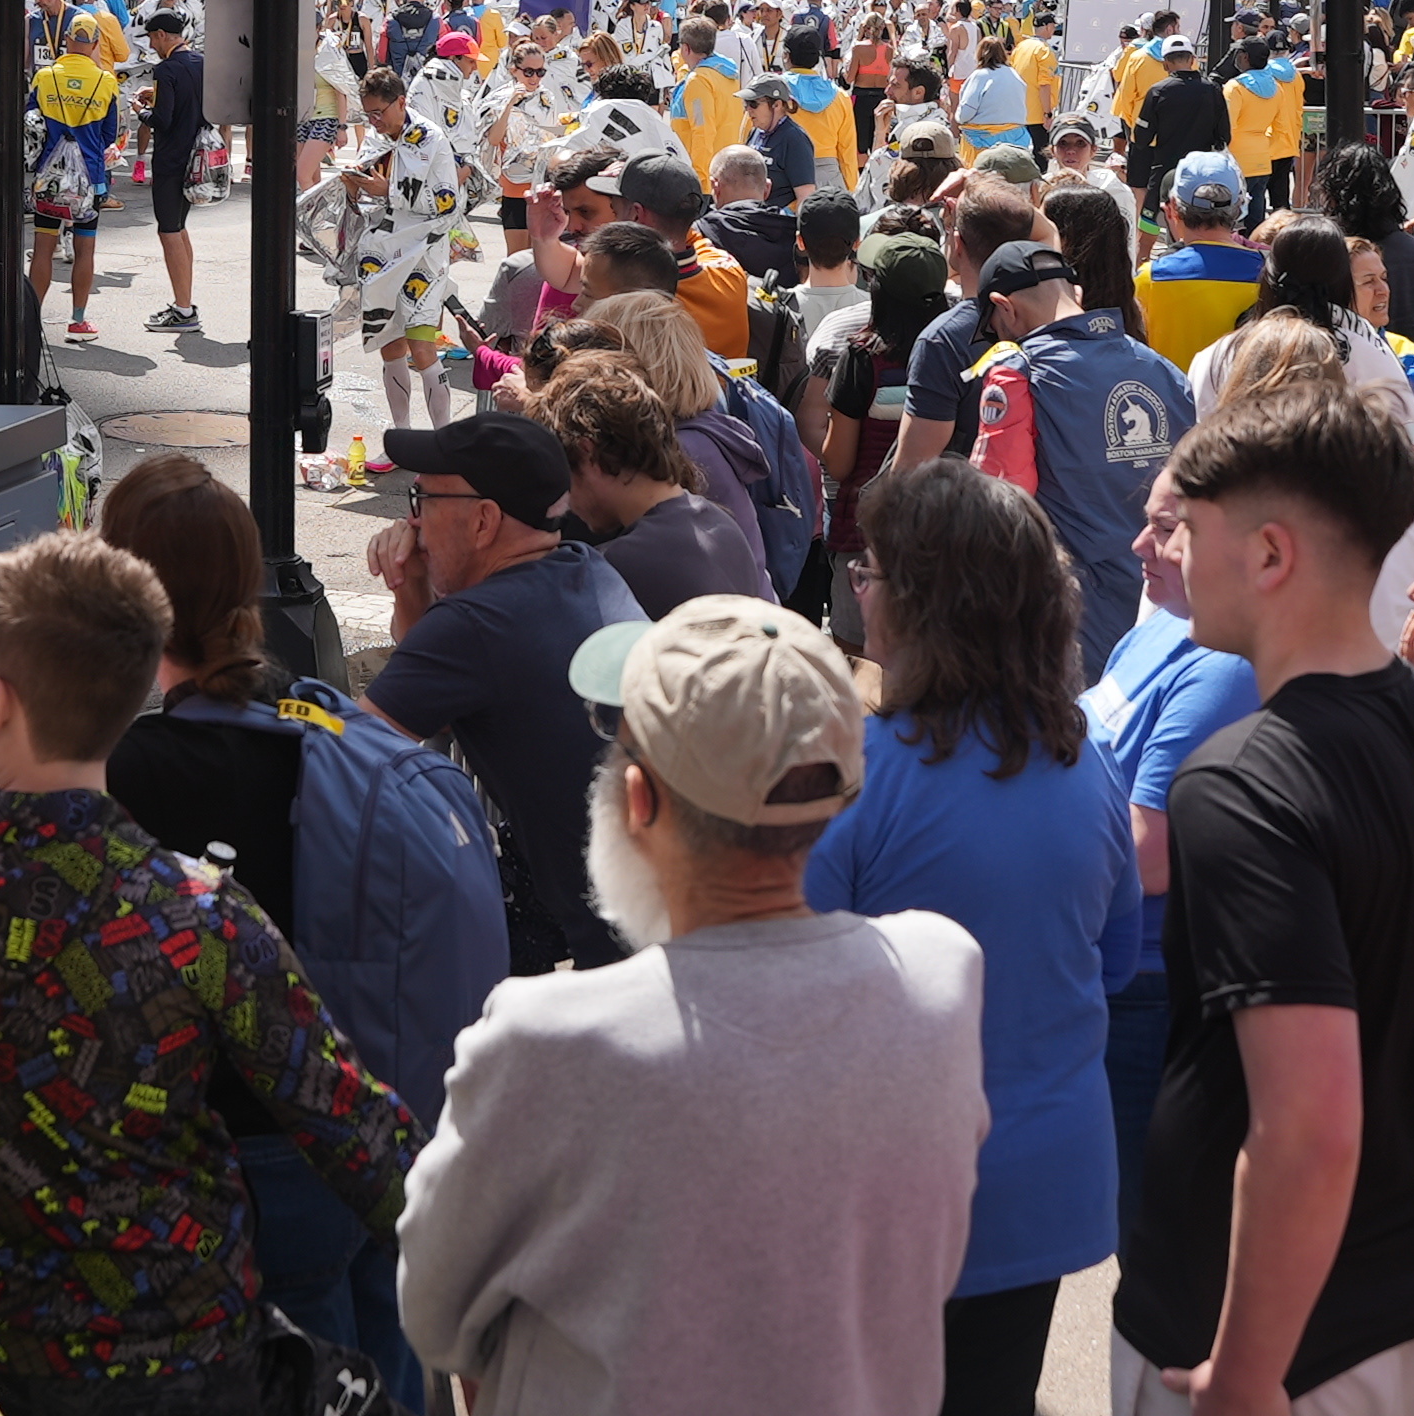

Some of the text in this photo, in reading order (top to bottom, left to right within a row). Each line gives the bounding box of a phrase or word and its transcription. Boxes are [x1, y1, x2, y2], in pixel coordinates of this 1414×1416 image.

[1106, 384, 1168, 445] BOSTON ATHLETIC ASSOCIATION
[1106, 446, 1171, 460] BOSTON MARATHON
